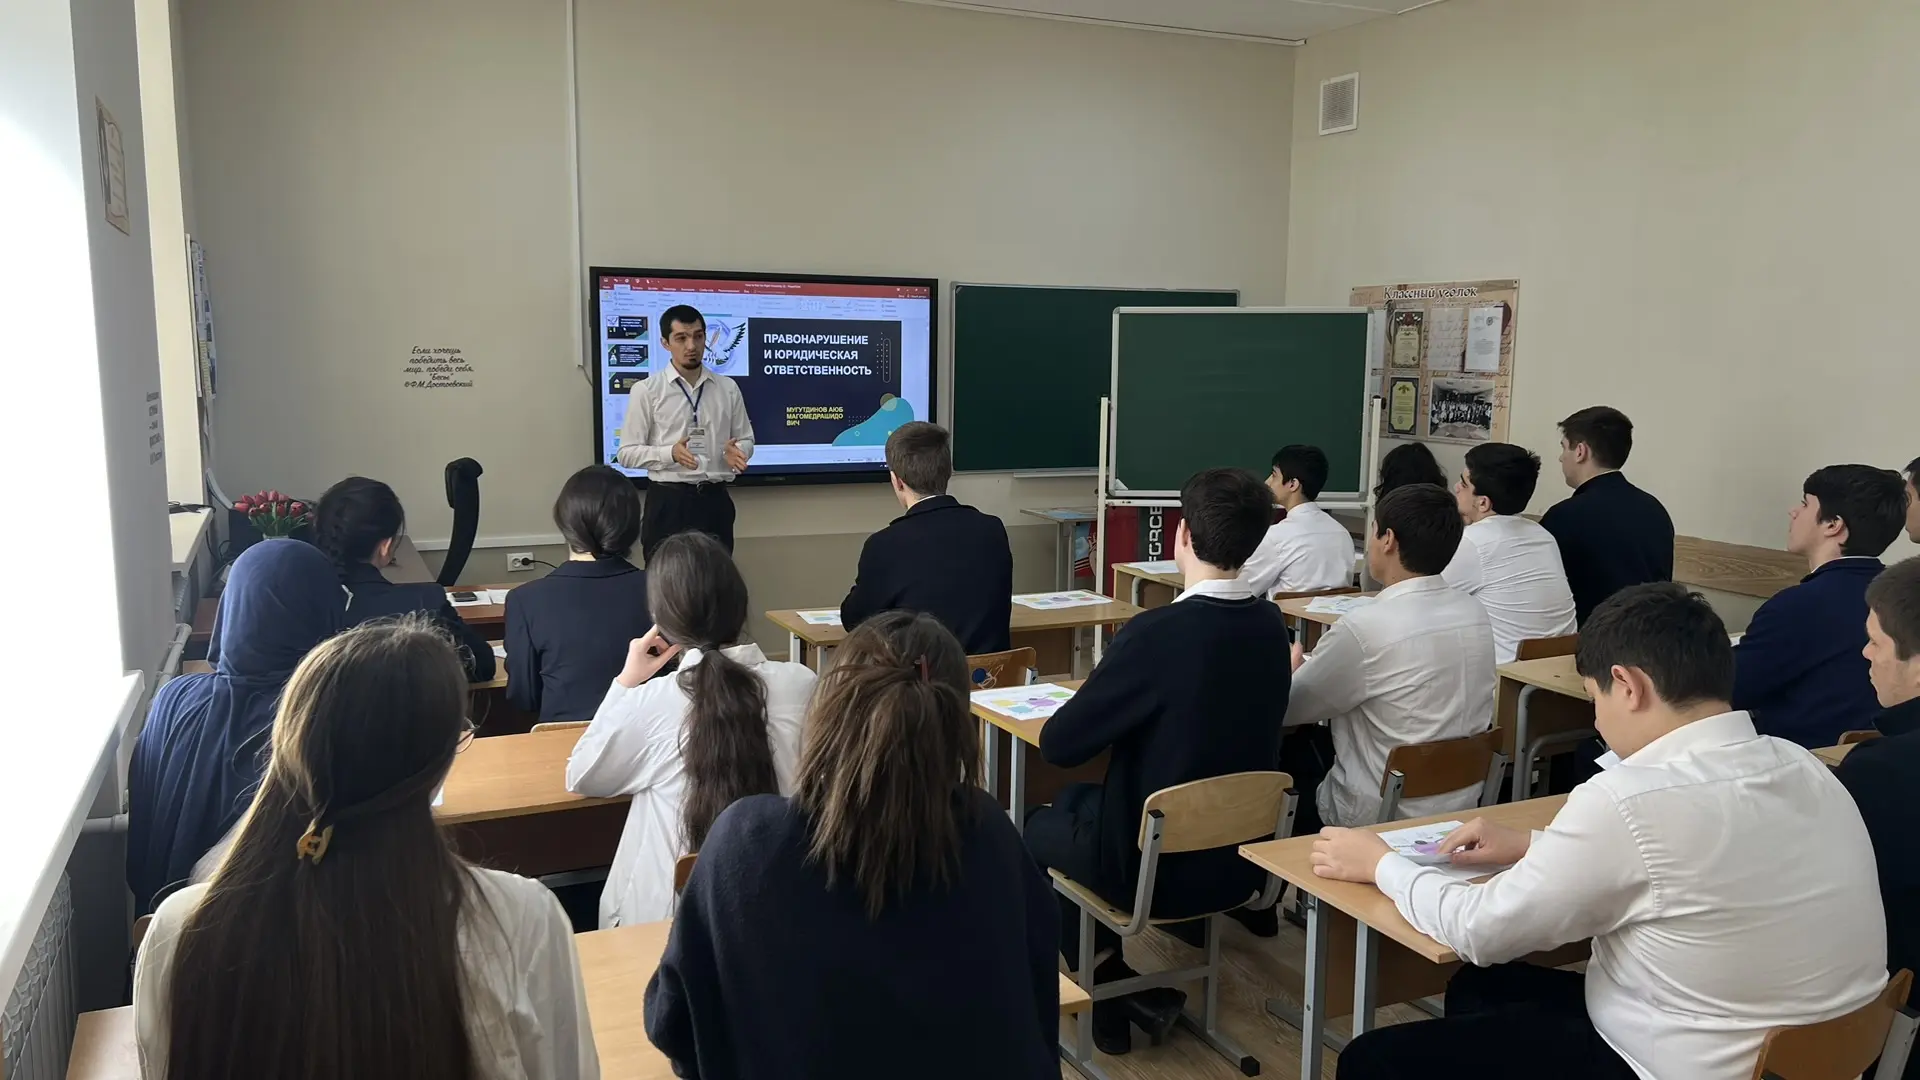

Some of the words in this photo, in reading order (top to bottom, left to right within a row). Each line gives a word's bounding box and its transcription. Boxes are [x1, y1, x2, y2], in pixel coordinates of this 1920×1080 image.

[1384, 286, 1436, 300] Классный
[1436, 287, 1478, 304] уголок
[763, 333, 869, 345] ПРАВОНАРУШЕНИЕ
[763, 349, 772, 360] И
[774, 350, 859, 361] ЮРИДИЧЕСКАЯ
[763, 364, 872, 376] ОТВЕТСТВЕННОСТЬ
